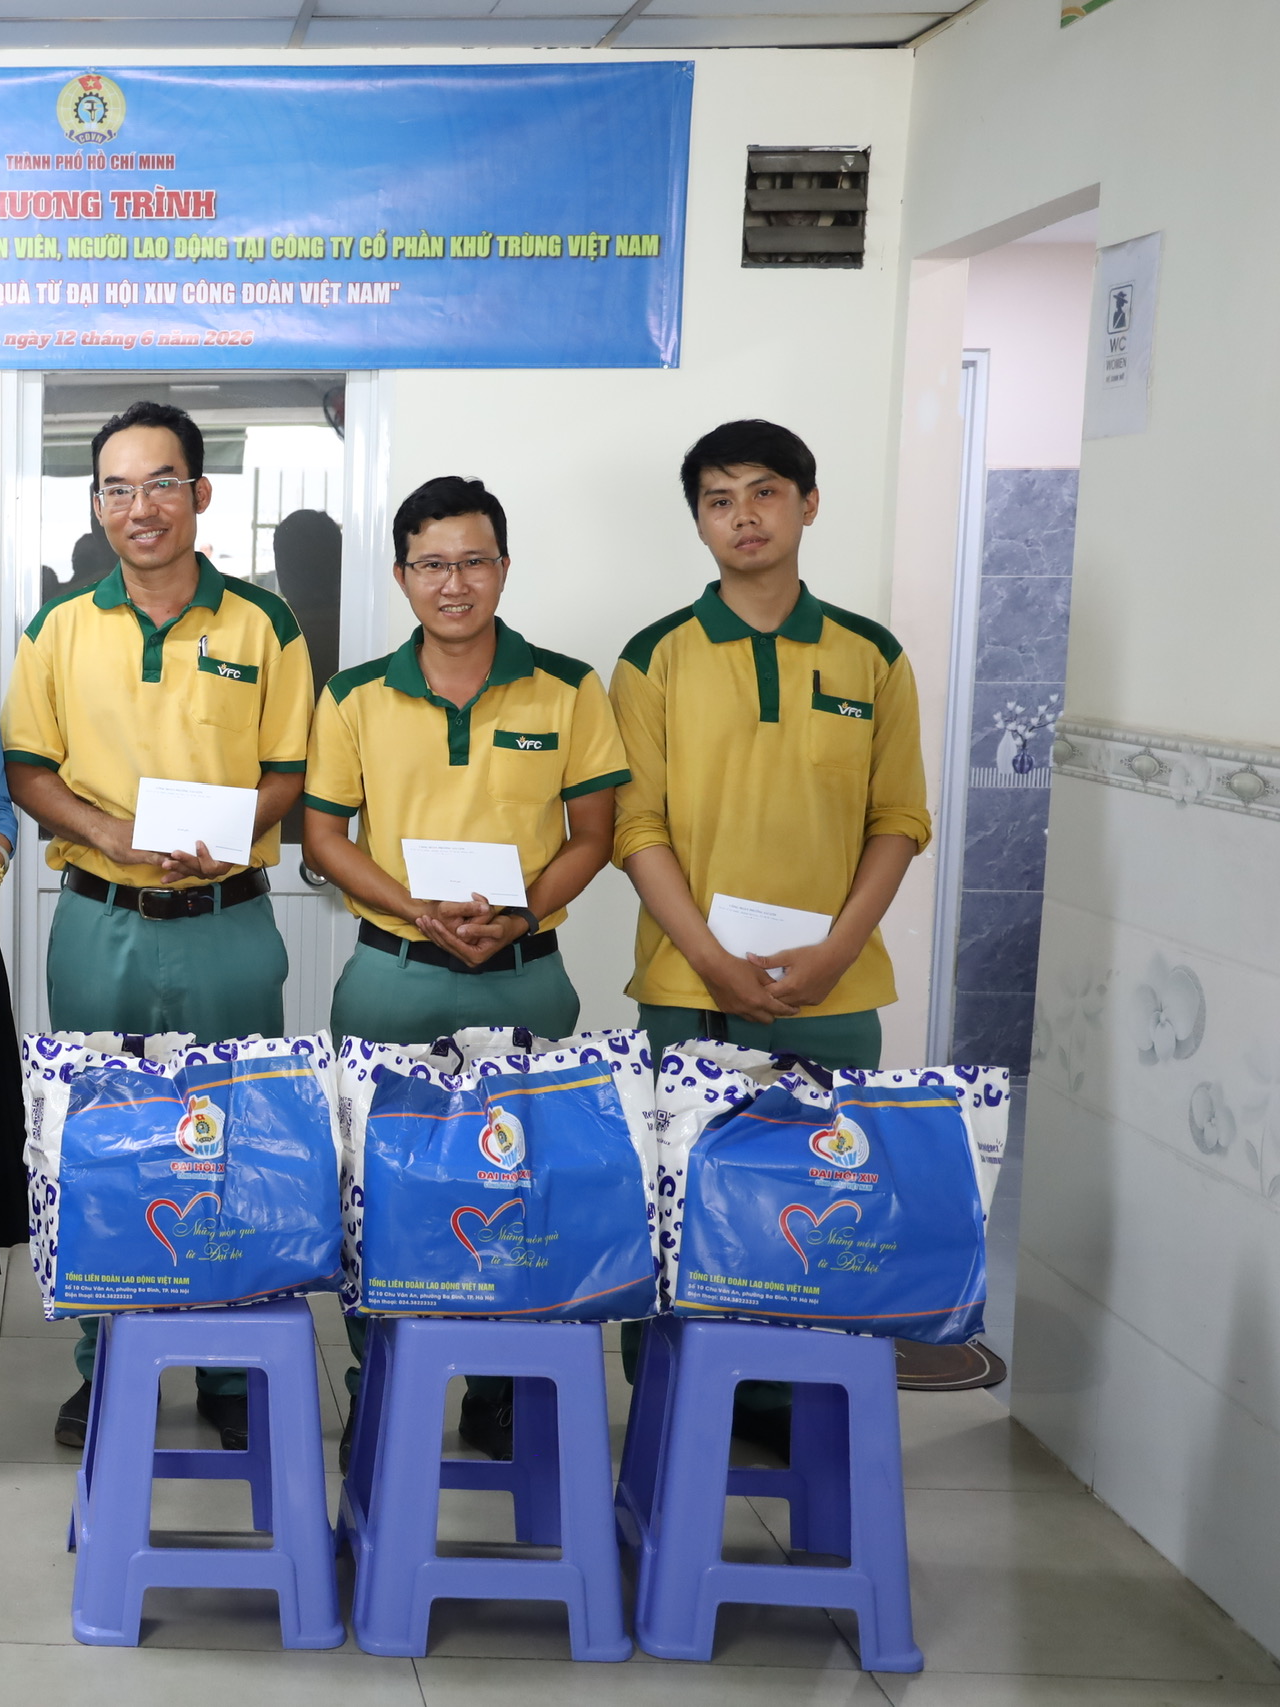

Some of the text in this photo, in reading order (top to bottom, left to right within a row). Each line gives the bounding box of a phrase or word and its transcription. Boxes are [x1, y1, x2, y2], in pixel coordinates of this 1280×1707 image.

[6, 149, 175, 170] THÀNH PHỐ HỒ CHÍ MINH
[109, 184, 216, 219] TRÌNH
[14, 234, 62, 262] VIÊN,
[68, 233, 128, 259] NGƯỜI
[133, 236, 168, 259] LAO
[174, 234, 228, 263] ĐỘNG
[234, 236, 265, 263] TẠI
[270, 234, 326, 259] CÔNG
[330, 236, 354, 259] TY
[359, 229, 387, 259] CỔ
[392, 230, 444, 259] PHẦN
[450, 231, 493, 258] KHỬ
[496, 232, 563, 258] TRÙNG
[567, 232, 610, 261] VIỆT
[615, 234, 660, 258] NAM
[36, 279, 63, 304] TỪ
[66, 282, 99, 308] ĐẠI
[105, 280, 138, 308] HỘI
[144, 282, 178, 304] XIV
[182, 280, 236, 304] CÔNG
[242, 279, 294, 304] ĐOÀN
[300, 280, 342, 308] VIỆT
[347, 282, 400, 304] NAM"
[4, 330, 52, 349] ngày
[54, 330, 76, 346] 12
[80, 330, 137, 349] tháng
[139, 330, 155, 346] 6
[157, 330, 200, 346] năm
[203, 330, 255, 347] 2026
[1110, 336, 1126, 352] WC
[217, 666, 241, 678] VFC
[838, 704, 862, 718] VFC
[516, 740, 542, 749] VFC
[858, 1172, 879, 1183] XIV
[174, 1277, 190, 1285] NAM
[478, 1283, 495, 1291] NAM
[749, 1280, 763, 1288] LAO
[803, 1286, 820, 1295] NAM
